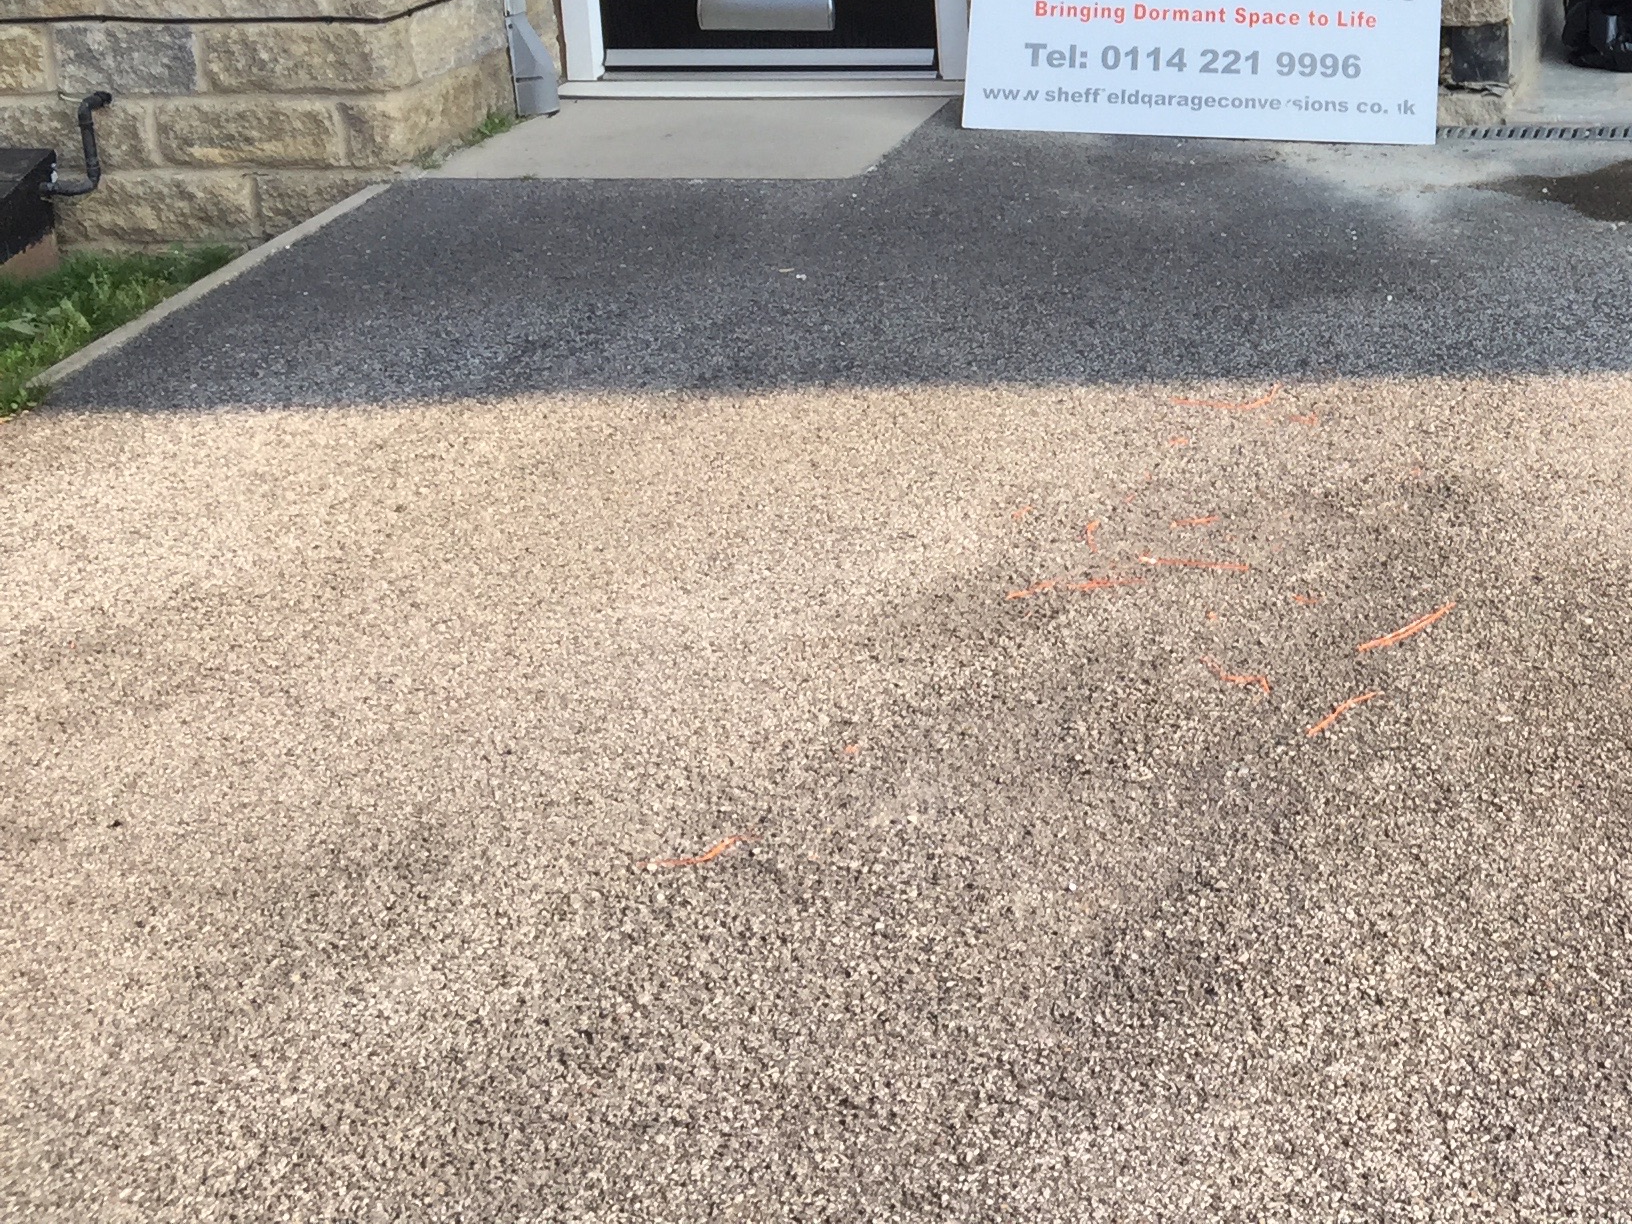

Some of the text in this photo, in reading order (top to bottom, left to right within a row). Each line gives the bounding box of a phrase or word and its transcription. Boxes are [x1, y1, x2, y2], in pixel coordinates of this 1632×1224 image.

[1034, 0, 1377, 29] Bringing Dormant Space to Life
[1024, 42, 1362, 79] Tel: 0114 221 9996
